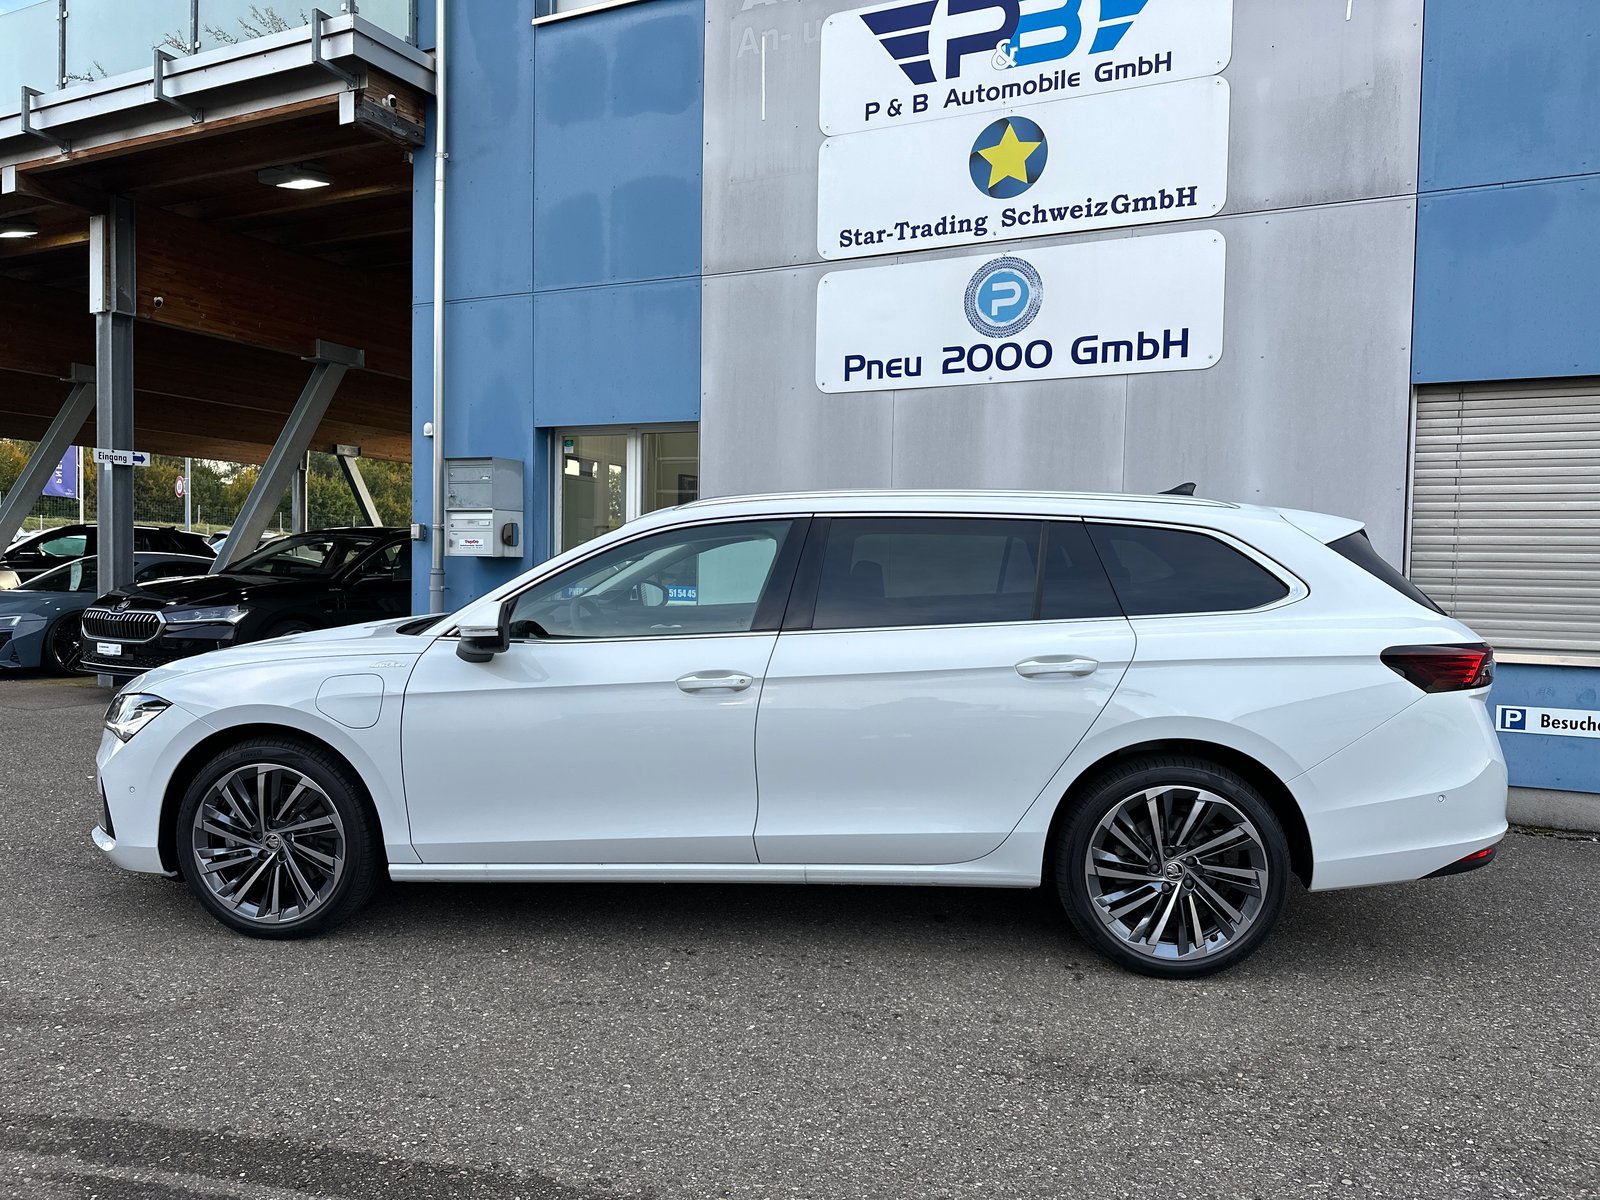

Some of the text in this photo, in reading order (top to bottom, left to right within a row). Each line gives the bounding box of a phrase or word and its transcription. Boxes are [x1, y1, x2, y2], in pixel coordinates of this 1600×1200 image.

[865, 50, 1173, 121] P & B Automobile GmbH
[838, 214, 988, 248] Star-Trading
[844, 327, 1191, 382] Pneu 2000 GmbH
[98, 451, 128, 463] Eingang
[668, 588, 697, 599] 51 54 45
[1540, 713, 1600, 732] Besuch
